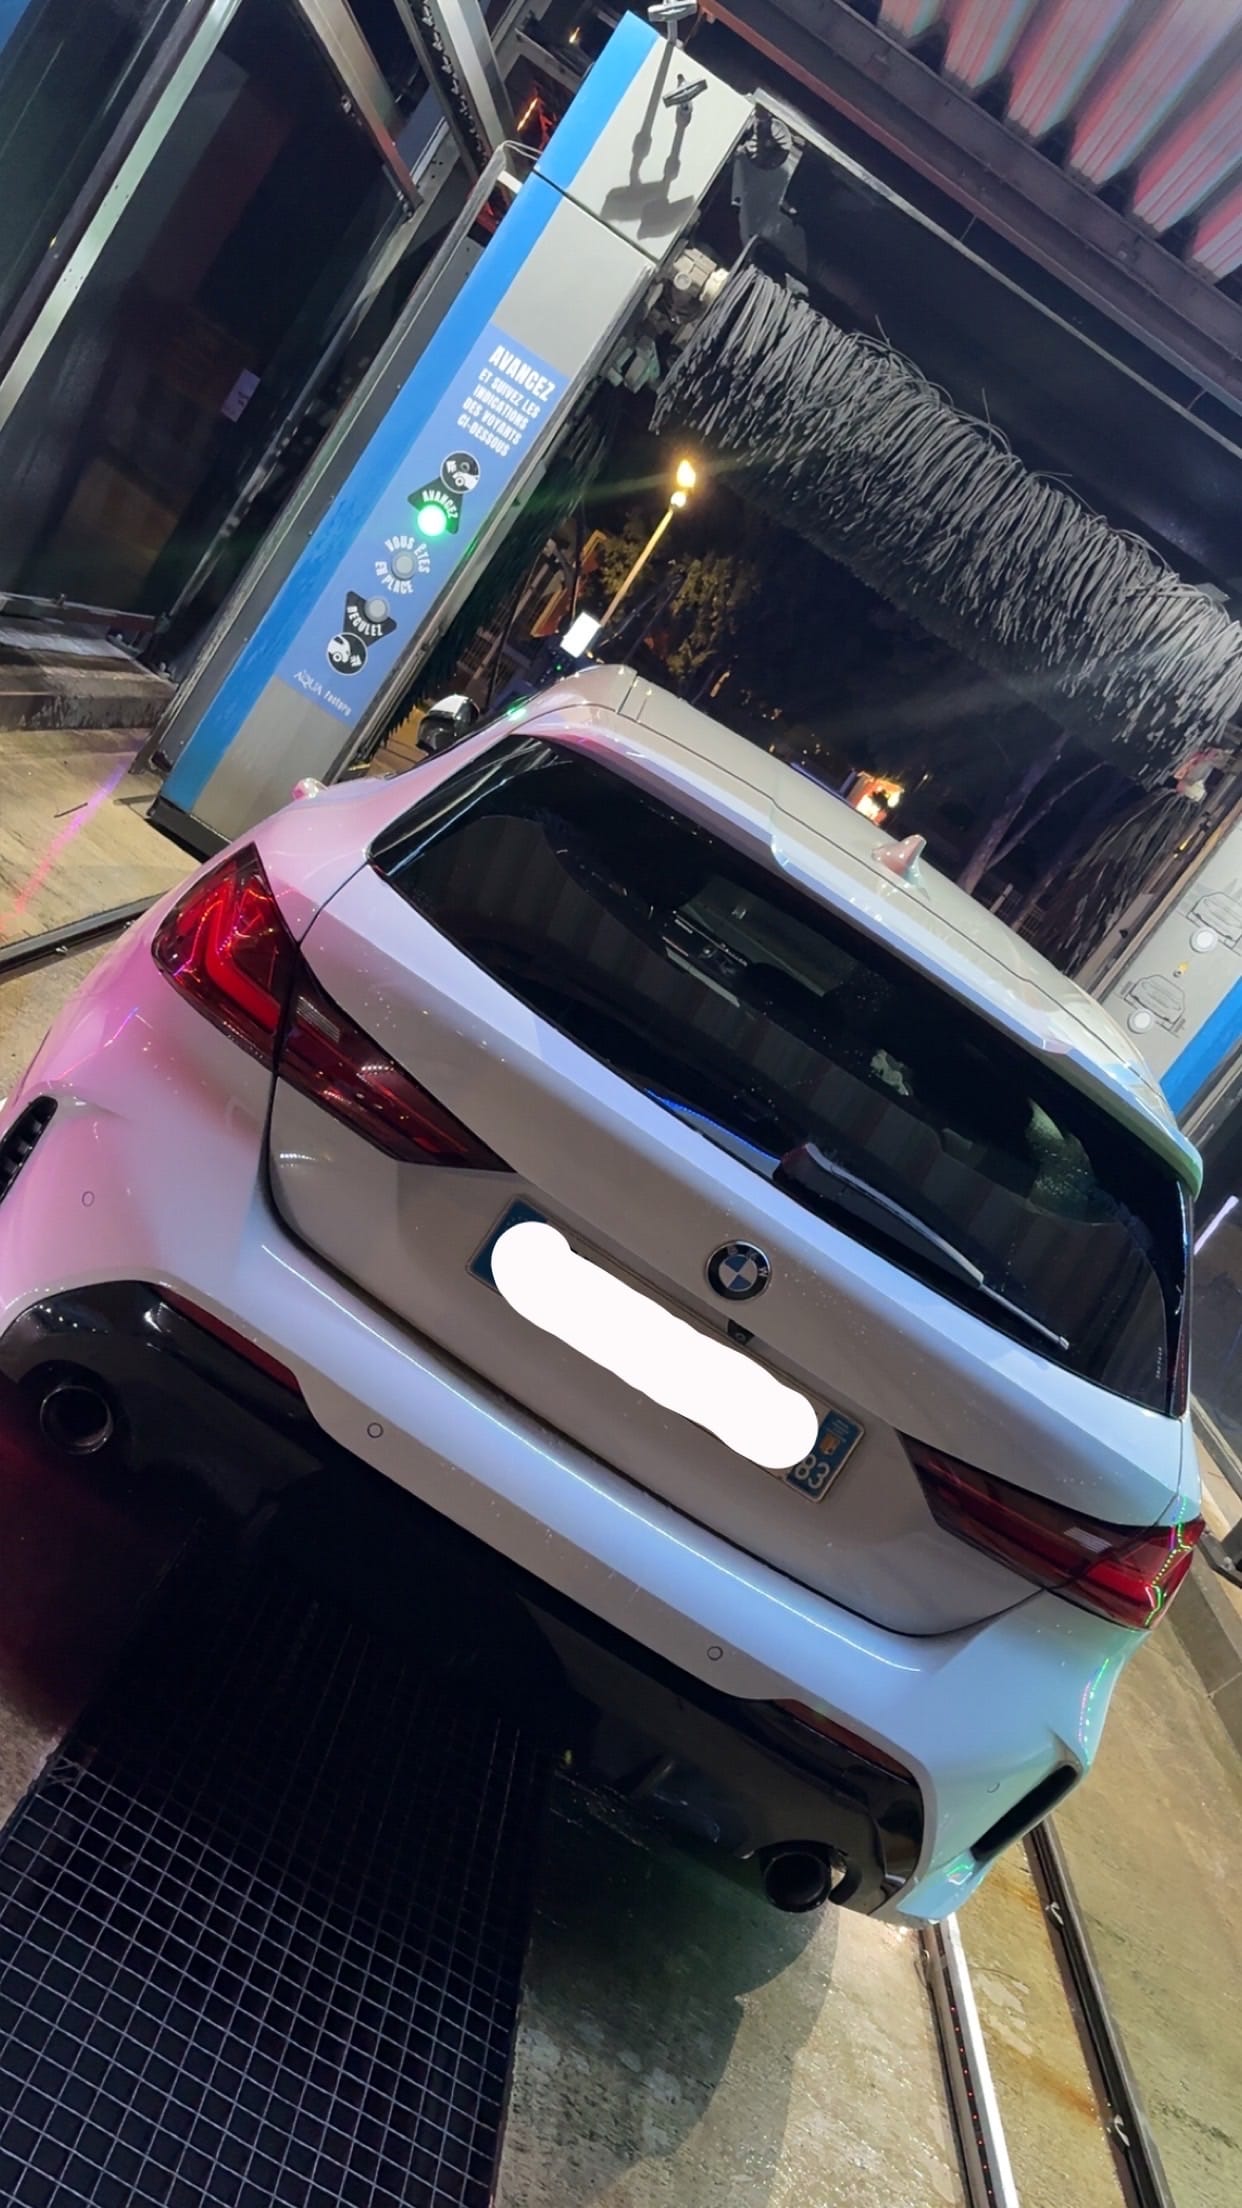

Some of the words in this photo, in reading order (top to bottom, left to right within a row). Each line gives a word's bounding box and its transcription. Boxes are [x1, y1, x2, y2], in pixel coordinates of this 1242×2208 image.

[479, 368, 493, 383] ET
[491, 377, 524, 406] SUIVEZ
[522, 400, 540, 418] LES
[488, 344, 556, 402] AVANCEZ
[463, 397, 482, 417] DES
[481, 410, 522, 445] VOYANTS
[472, 383, 529, 431] INDICATIONS
[457, 413, 511, 457] CI-DESSOUS
[421, 489, 459, 519] AVANCEZ
[384, 535, 416, 553] VOUS
[375, 561, 388, 577] EN
[381, 575, 414, 594] PLACE
[795, 1453, 831, 1489] 83
